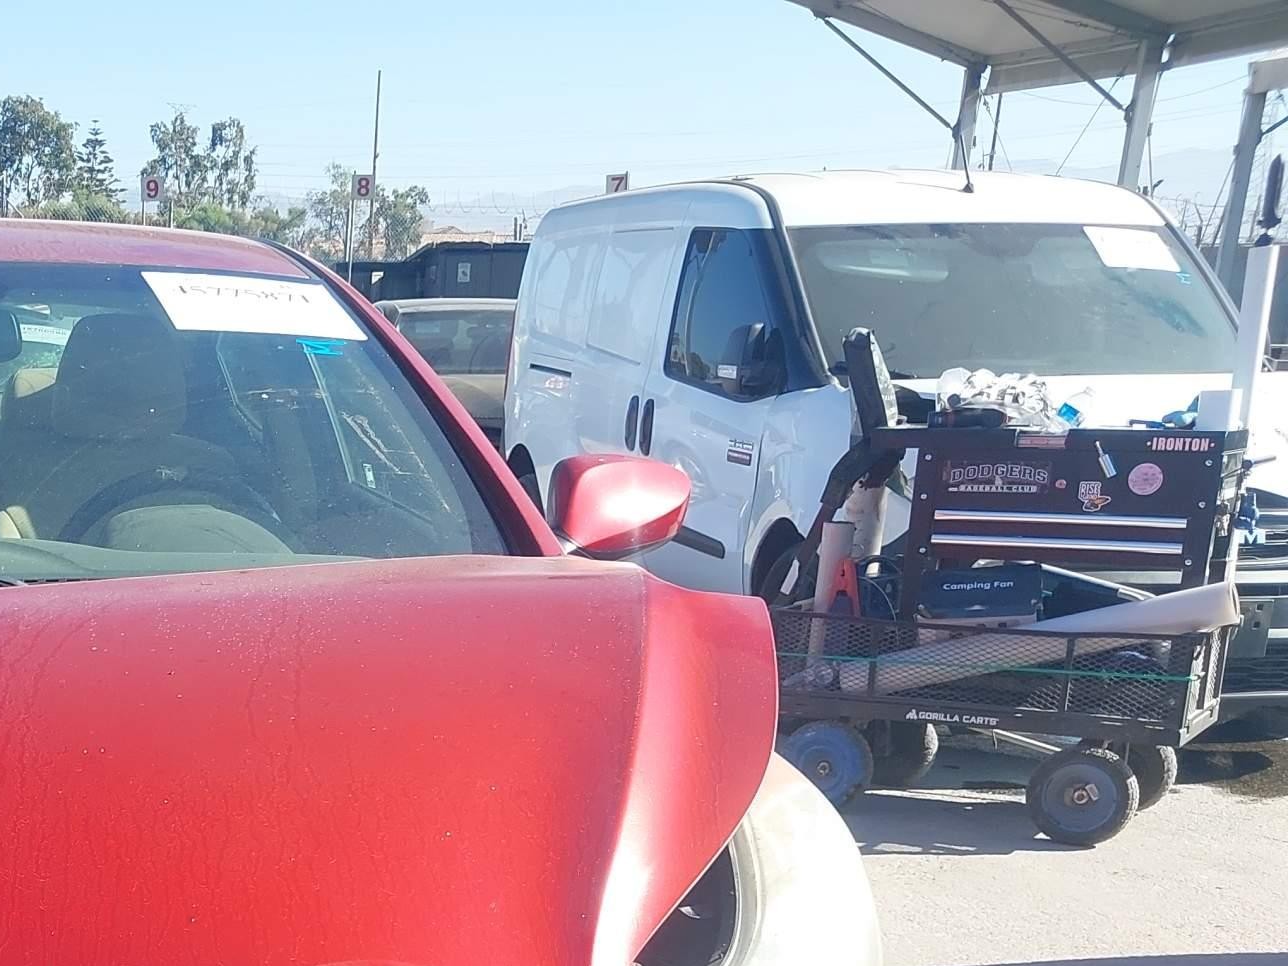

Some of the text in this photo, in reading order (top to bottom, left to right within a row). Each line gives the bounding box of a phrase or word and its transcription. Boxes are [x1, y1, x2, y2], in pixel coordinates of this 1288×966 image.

[144, 179, 159, 199] 9
[356, 177, 370, 197] 8
[610, 176, 626, 193] 7
[1151, 436, 1210, 452] IRONTON
[950, 463, 1049, 484] DODGERS
[959, 484, 1038, 493] BASEBALL CLUB
[1079, 482, 1100, 497] RISE
[943, 580, 1014, 591] Camping Fan
[918, 711, 998, 726] GORILLA CARTS
